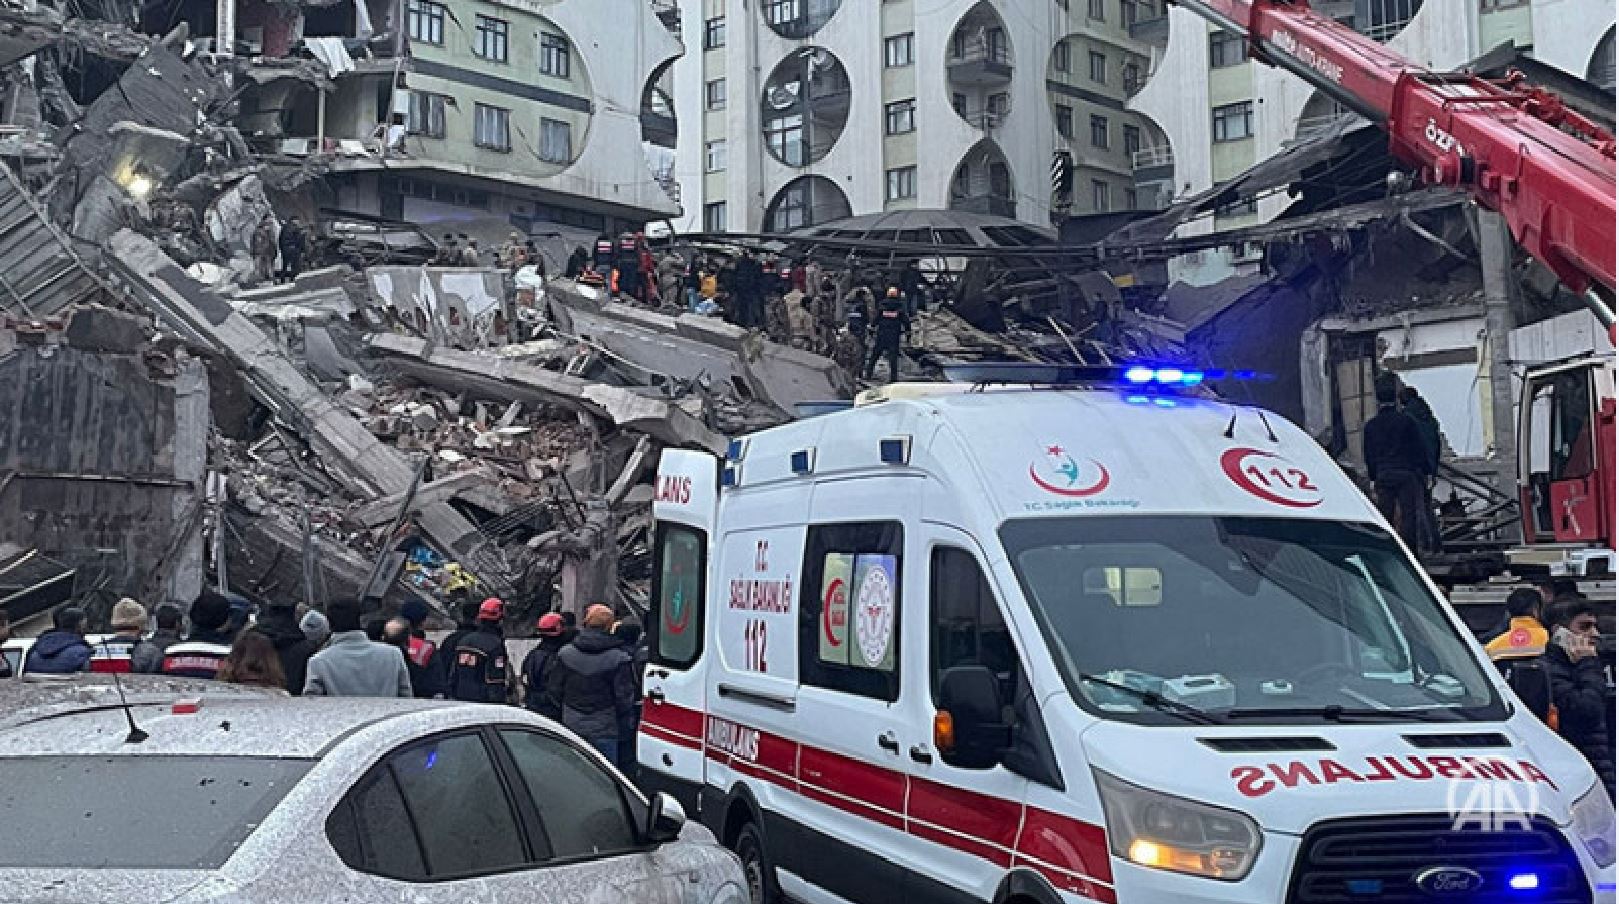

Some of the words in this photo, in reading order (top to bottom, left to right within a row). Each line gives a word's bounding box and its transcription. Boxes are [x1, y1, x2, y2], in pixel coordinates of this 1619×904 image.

[1247, 464, 1318, 491] 112
[744, 618, 768, 673] 112
[707, 716, 761, 762] AMBULANS
[1433, 872, 1470, 890] Ford
